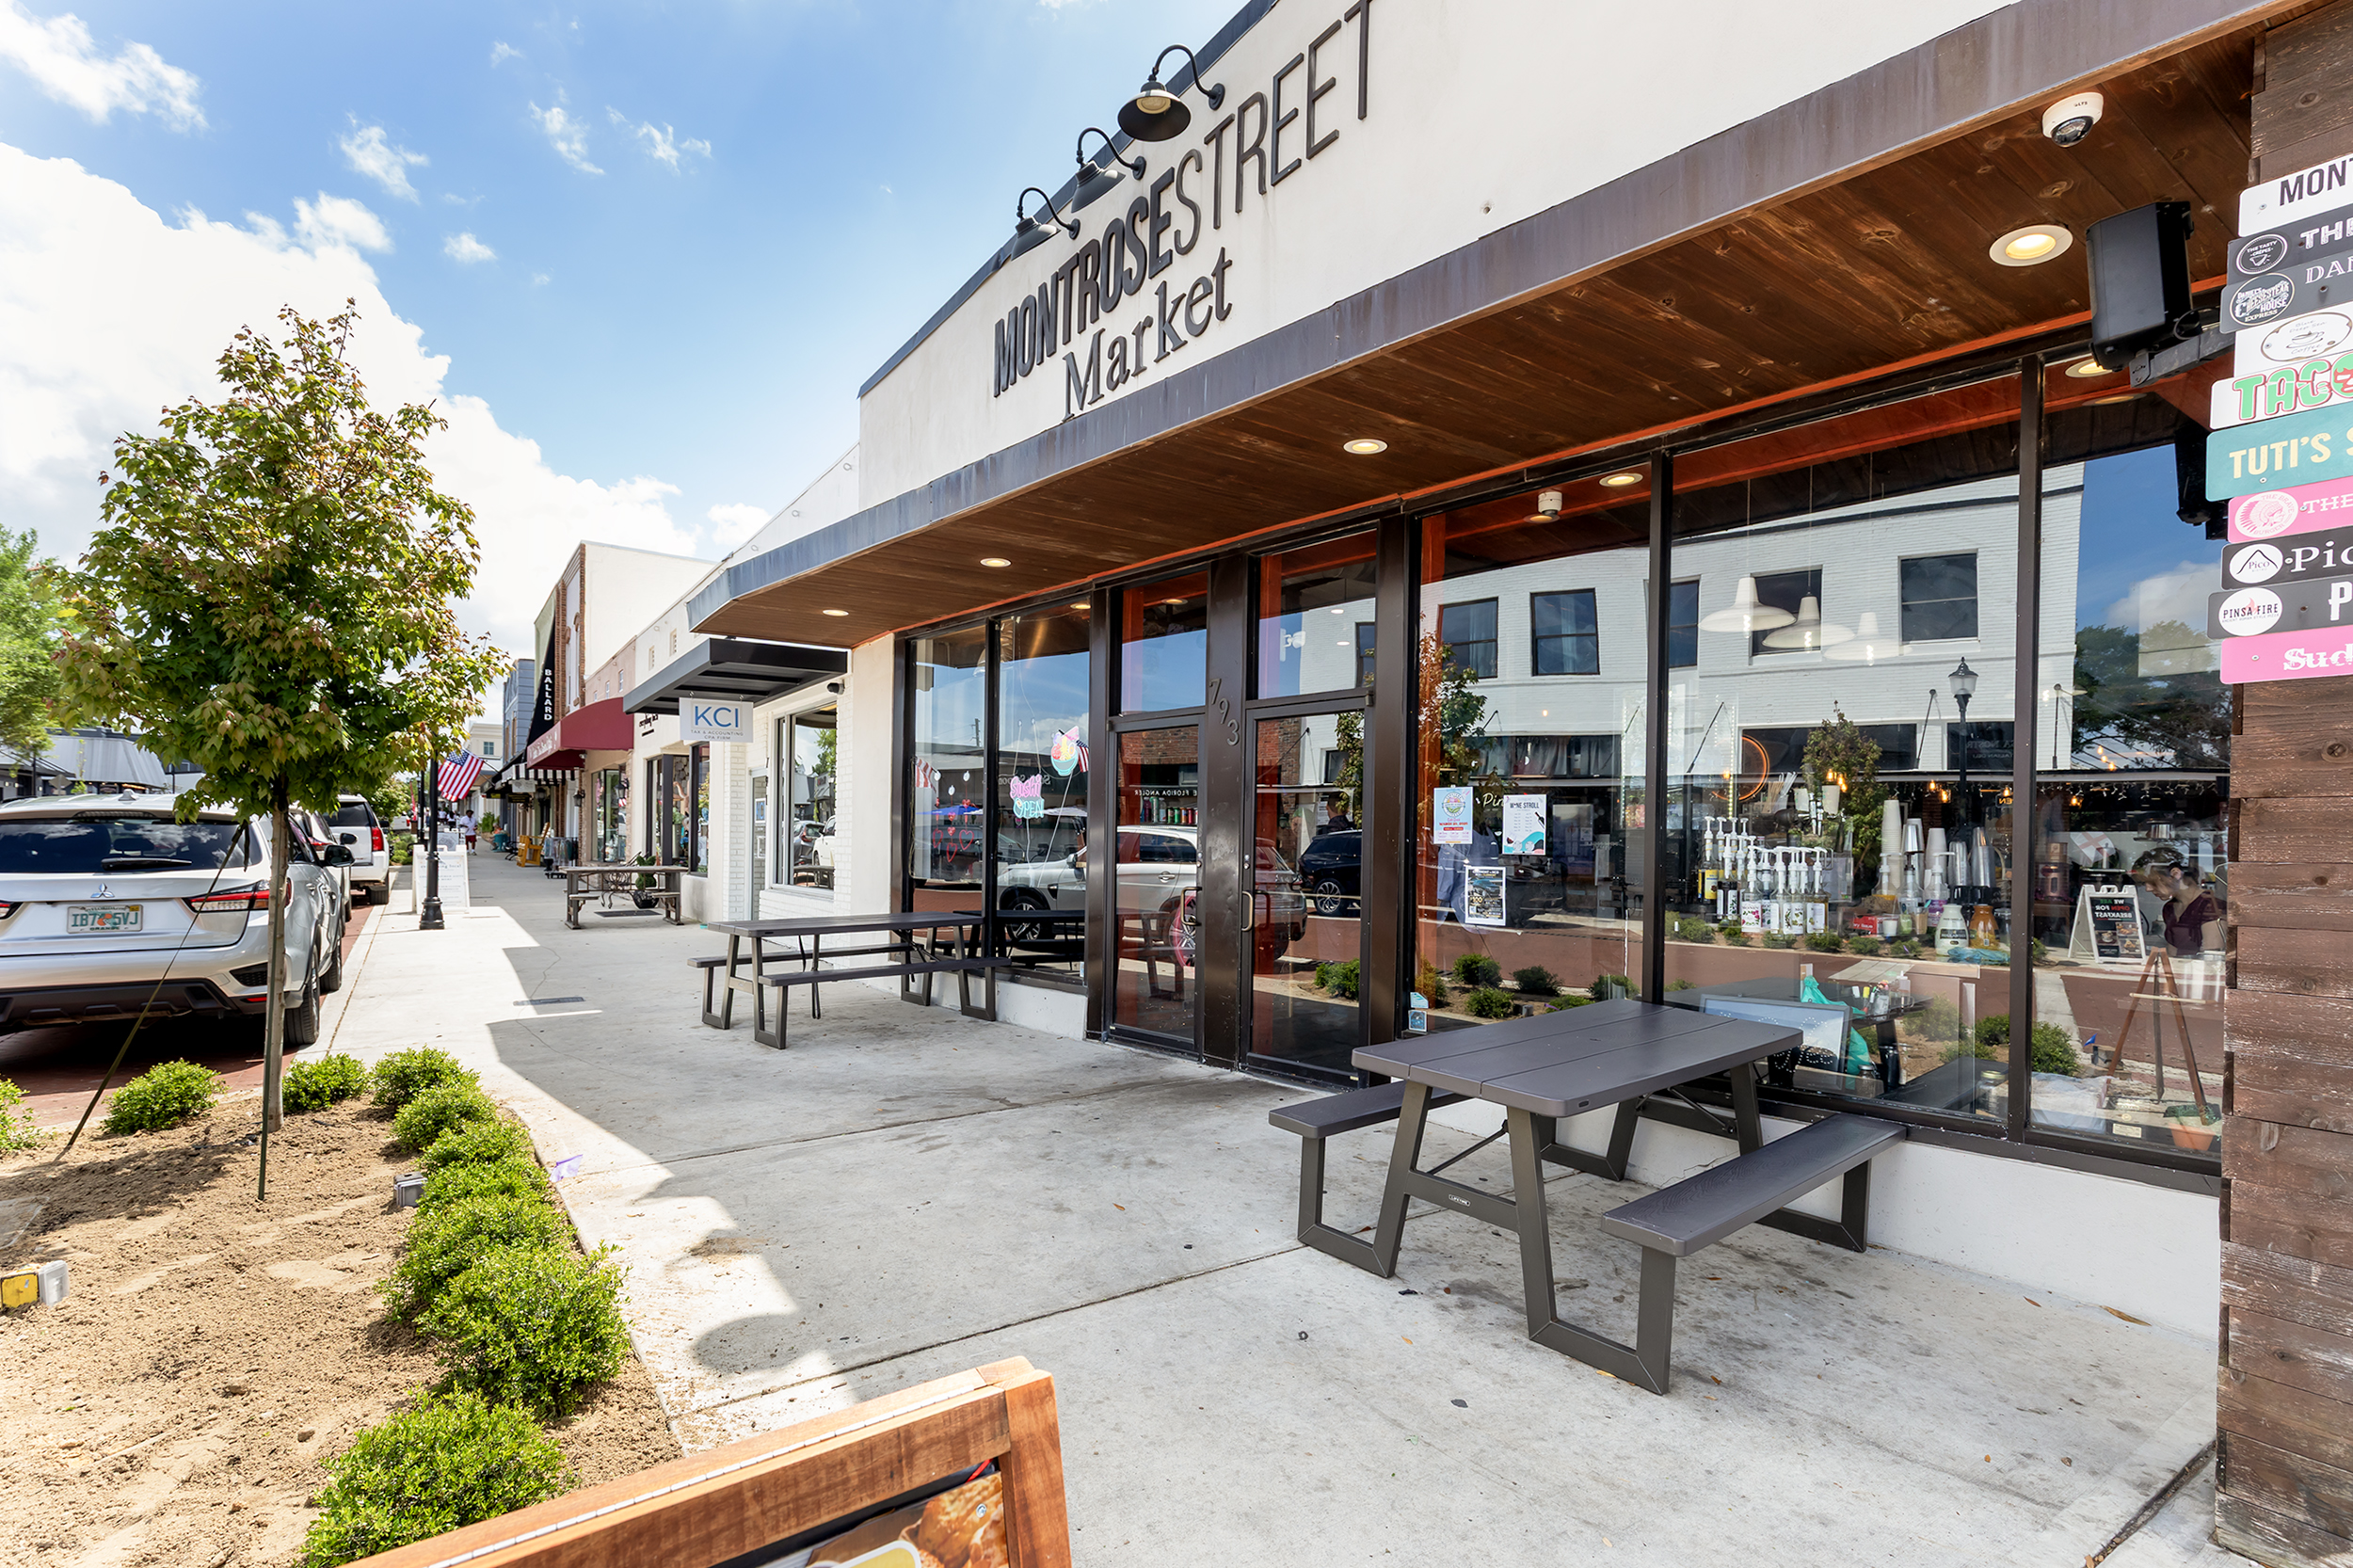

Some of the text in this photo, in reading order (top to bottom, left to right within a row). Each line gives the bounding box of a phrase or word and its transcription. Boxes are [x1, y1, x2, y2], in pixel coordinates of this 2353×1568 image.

[2280, 158, 2353, 206] MON
[2245, 309, 2278, 322] EXPRESS
[2260, 298, 2287, 312] HOUSE
[1062, 247, 1232, 424] Market
[2291, 344, 2322, 355] Coffee
[2229, 433, 2331, 479] TUTI'S
[2253, 523, 2285, 535] BURGER
[2223, 603, 2279, 618] PINSA FIRE
[543, 668, 552, 721] BALLARD
[695, 705, 739, 728] KCI
[1209, 678, 1240, 746] 793
[1014, 798, 1044, 819] OPEN
